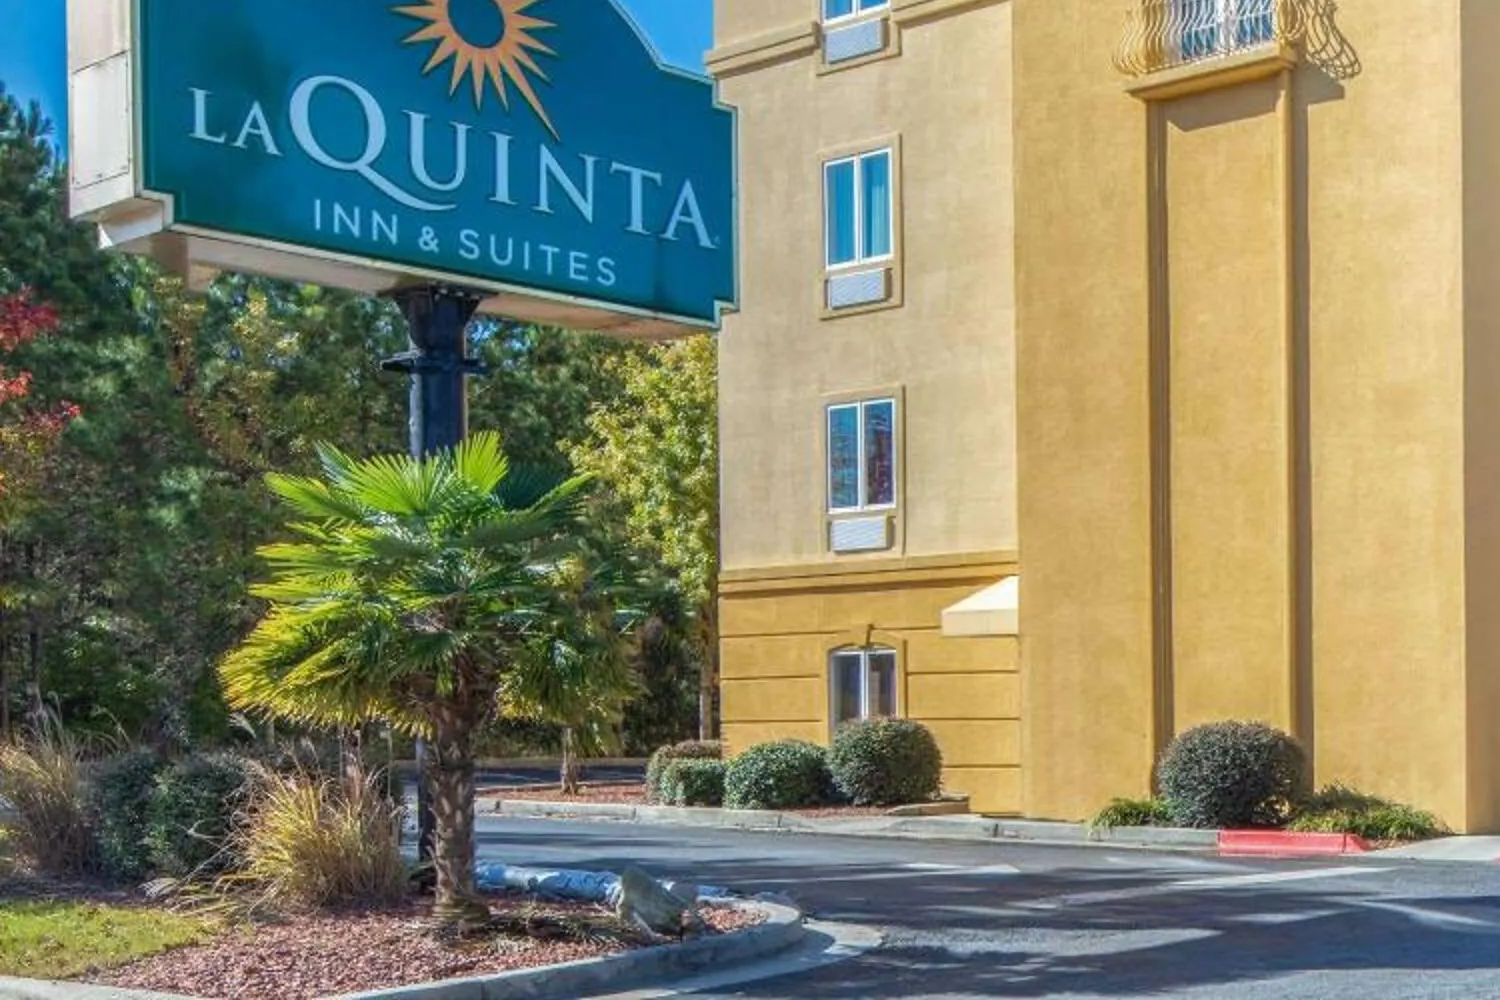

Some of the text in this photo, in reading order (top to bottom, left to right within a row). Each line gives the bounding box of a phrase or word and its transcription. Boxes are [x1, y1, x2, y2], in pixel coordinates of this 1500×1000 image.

[188, 75, 716, 249] LA QUINTA
[314, 199, 617, 286] INN & SUITES
